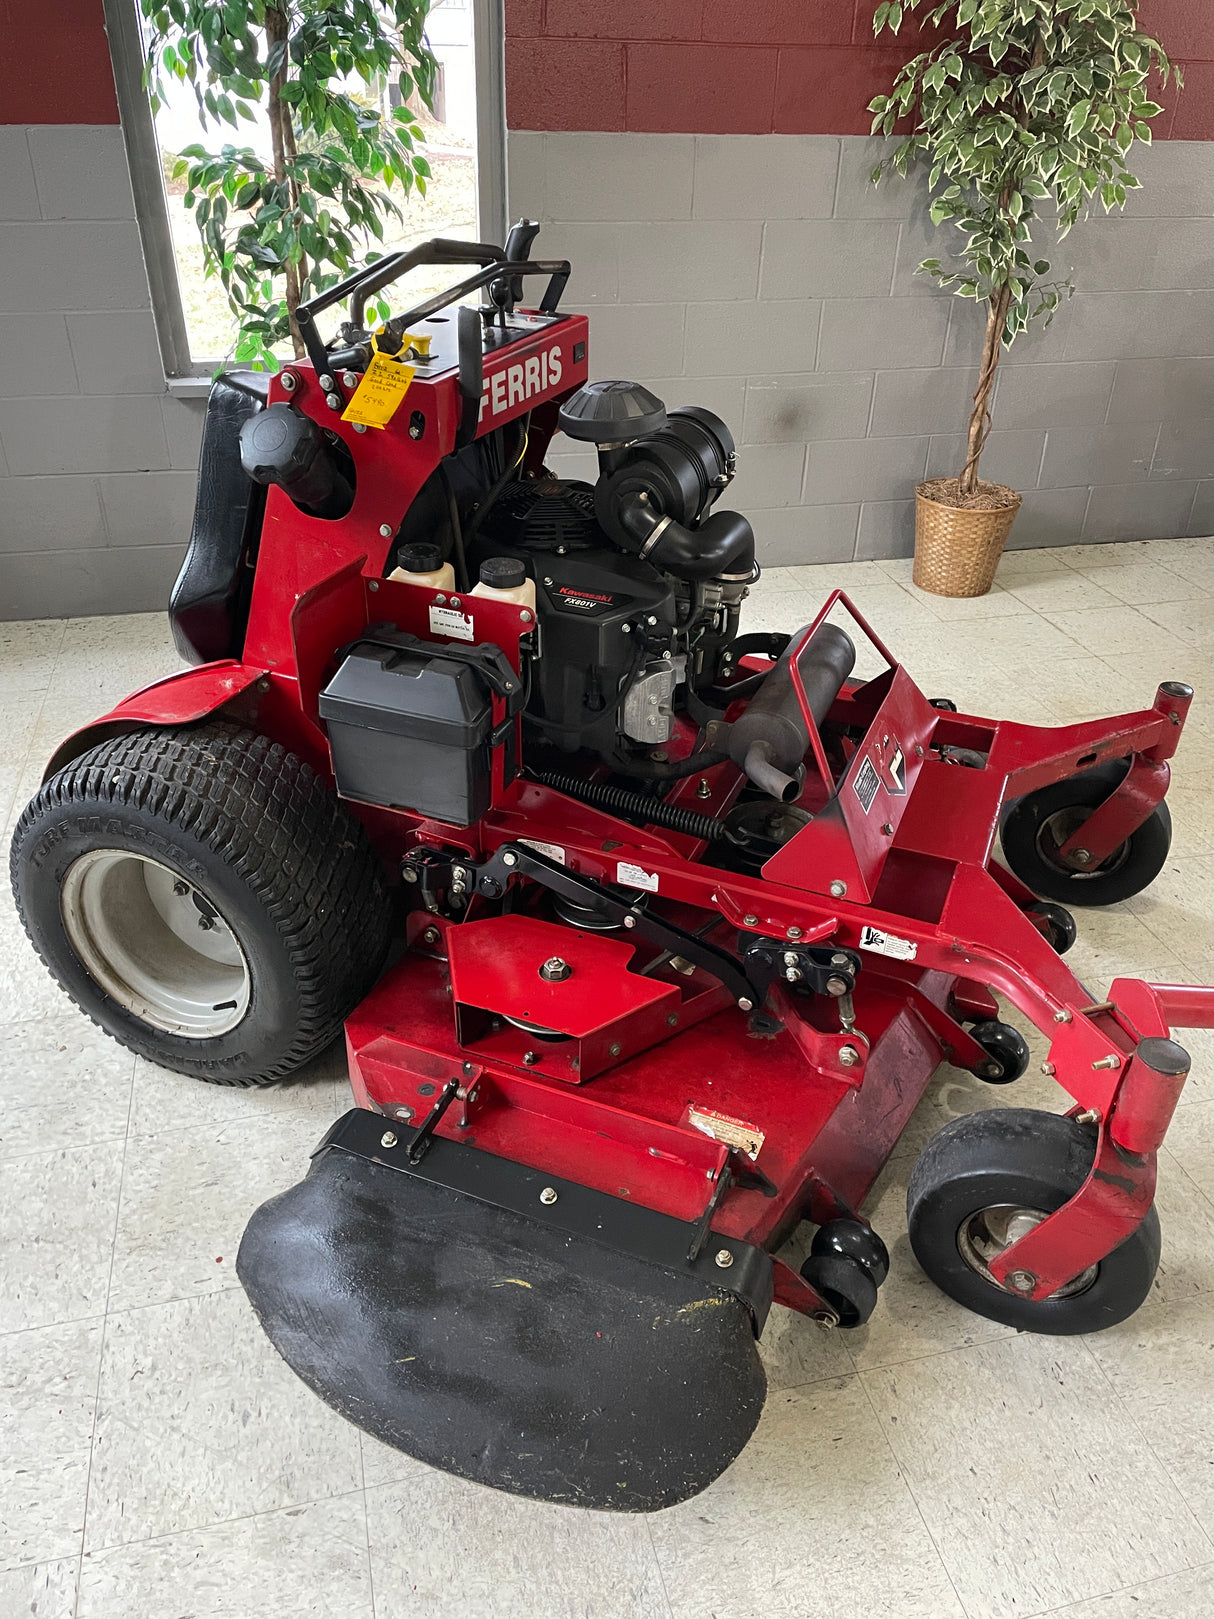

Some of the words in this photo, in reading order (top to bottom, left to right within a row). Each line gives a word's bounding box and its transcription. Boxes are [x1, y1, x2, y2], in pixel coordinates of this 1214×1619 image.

[478, 345, 562, 423] FERRIS
[559, 586, 613, 603] Kawasaki
[564, 597, 597, 608] FX801V
[716, 1113, 745, 1127] DANGER
